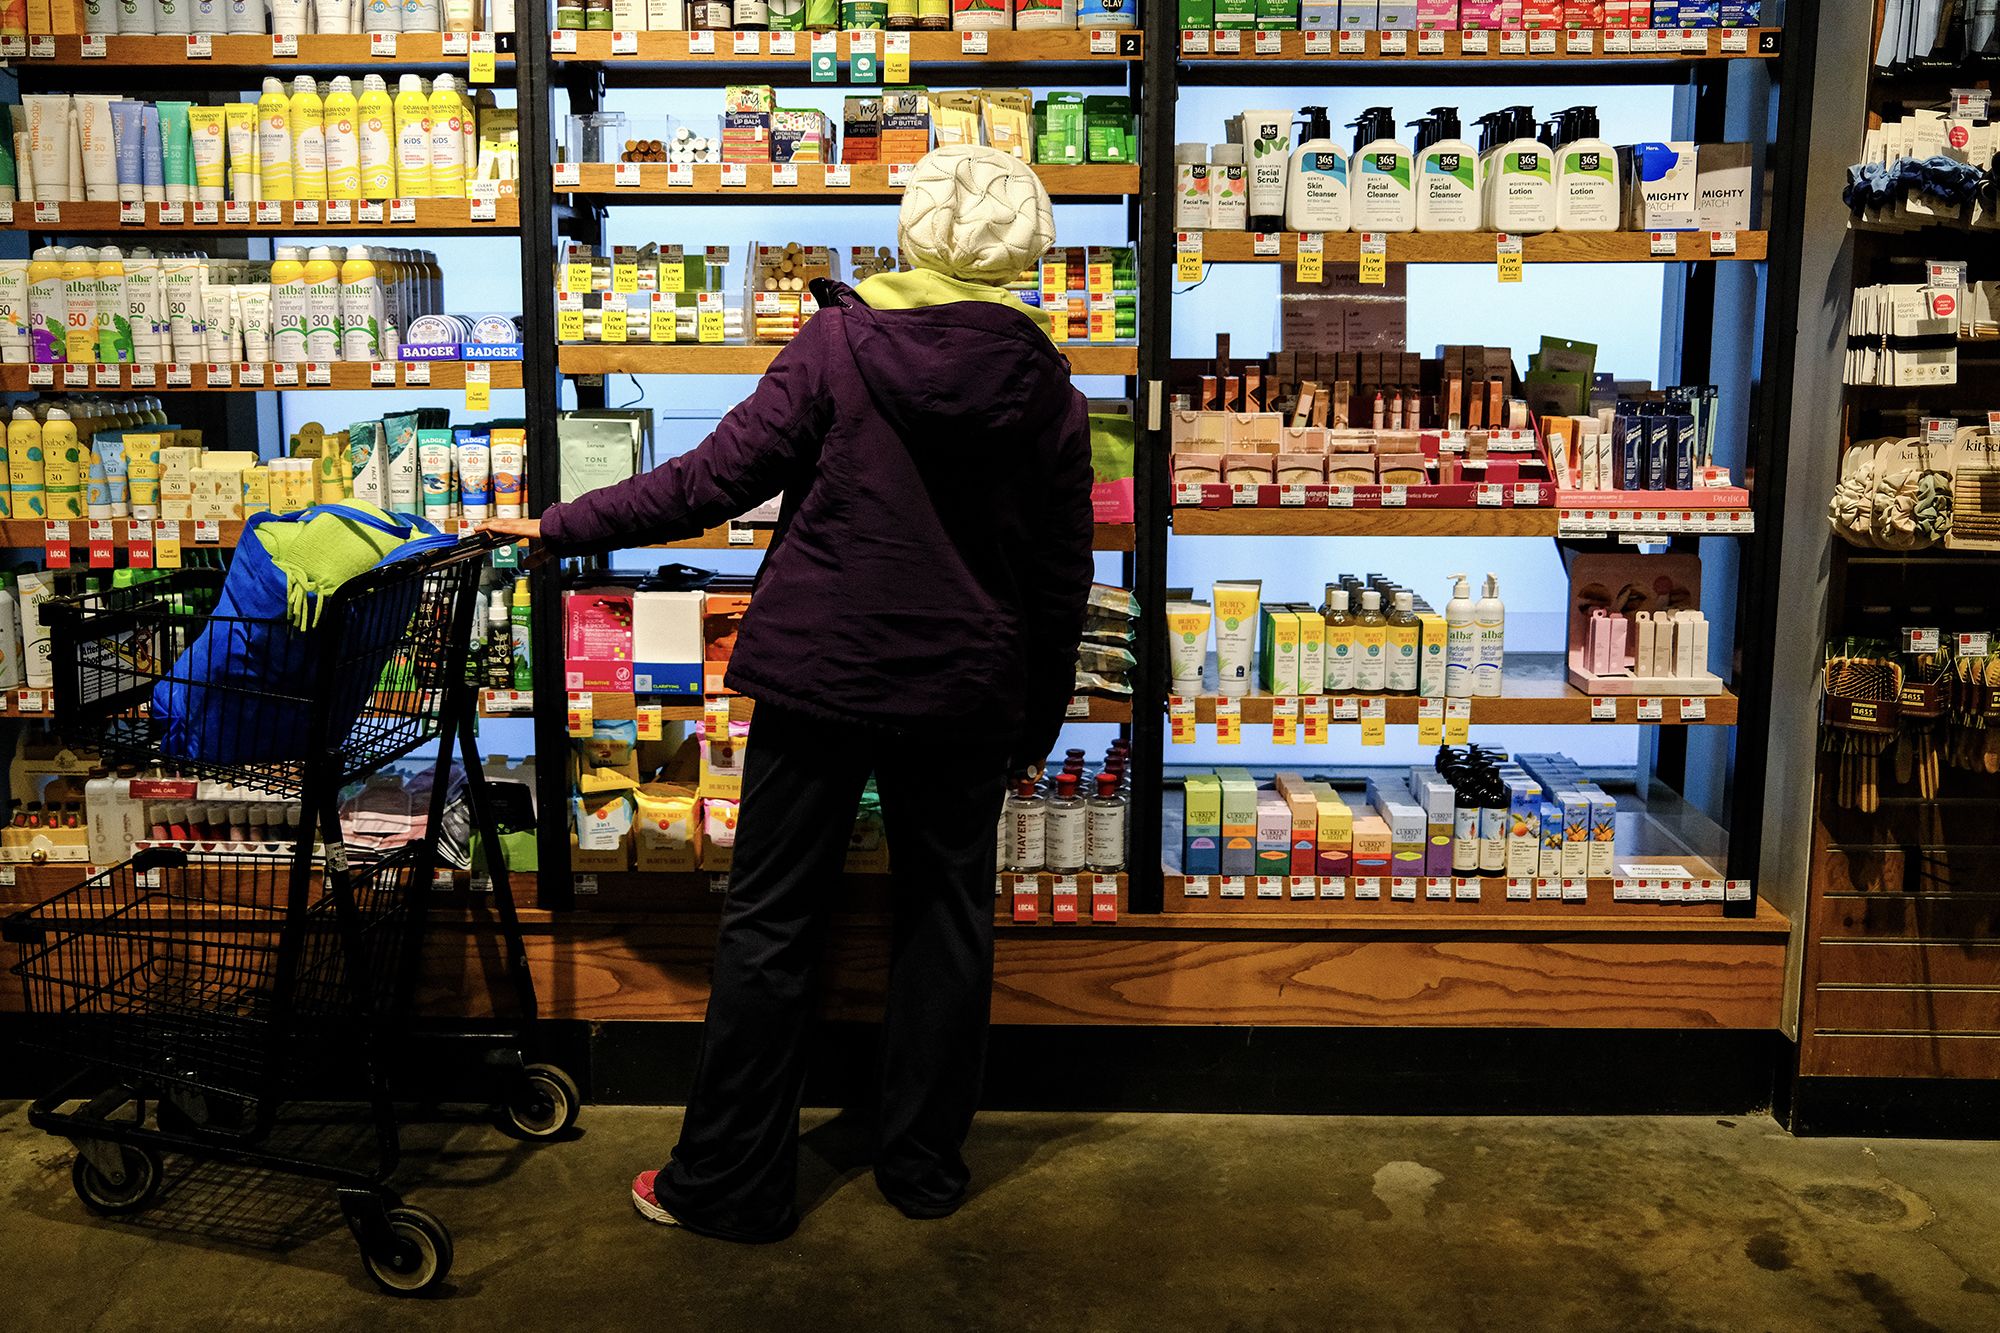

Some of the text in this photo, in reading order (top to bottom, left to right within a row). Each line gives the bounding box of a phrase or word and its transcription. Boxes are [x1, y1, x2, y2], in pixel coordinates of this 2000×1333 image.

[1102, 0, 1122, 8] CLAY
[501, 36, 507, 48] 1
[1126, 40, 1134, 51] 2
[1050, 103, 1078, 111] WELEDA
[271, 118, 284, 127] 40
[368, 121, 381, 129] 50
[448, 119, 460, 129] 50
[338, 123, 351, 132] 60
[1261, 126, 1276, 136] 365
[1316, 154, 1333, 165] 365
[1377, 155, 1394, 166] 365
[1440, 156, 1458, 165] 365
[1519, 155, 1536, 165] 365
[1580, 155, 1598, 165] 365
[1193, 167, 1205, 175] 365
[1228, 167, 1241, 176] 365
[1256, 168, 1279, 176] Facial
[1256, 176, 1279, 184] Scrub
[499, 185, 512, 194] 20
[1306, 182, 1323, 190] Skin
[1367, 182, 1389, 190] Facial
[1306, 190, 1337, 198] Cleanser
[1429, 191, 1461, 199] Cleanser
[1570, 187, 1594, 195] Lotion
[1701, 189, 1744, 198] MIGHTY
[1646, 192, 1690, 201] MIGHTY
[1701, 199, 1729, 208] PATCH
[618, 267, 633, 275] Low
[665, 266, 679, 274] Low
[1179, 264, 1200, 273] Price
[1299, 264, 1320, 273] Price
[1362, 265, 1383, 273] Price
[127, 274, 150, 283] alba
[167, 274, 190, 283] alba
[569, 275, 589, 283] Price
[616, 275, 635, 283] Price
[662, 274, 682, 282] Price
[65, 281, 94, 293] alba
[278, 284, 304, 295] alba
[310, 284, 335, 295] alba
[345, 284, 370, 295] alba
[130, 302, 146, 314] 50
[170, 302, 185, 313] 30
[68, 312, 86, 326] 50
[280, 314, 298, 326] 50
[312, 314, 330, 326] 30
[346, 314, 363, 326] 30
[564, 314, 578, 322] Low
[607, 315, 622, 323] Low
[656, 315, 670, 323] Low
[703, 315, 718, 323] Low
[562, 322, 581, 331] Price
[604, 323, 624, 331] Price
[653, 323, 673, 331] Price
[701, 323, 721, 331] Price
[402, 346, 454, 357] BADGER
[466, 347, 518, 357] BADGER
[421, 437, 447, 445] BADGER
[427, 456, 439, 465] 40
[466, 456, 479, 465] 40
[500, 456, 512, 464] 40
[401, 465, 413, 474] 30
[366, 482, 377, 491] 30
[285, 498, 297, 507] 30
[1712, 494, 1745, 503] PACIFICA
[50, 549, 67, 558] LOCAL
[93, 549, 110, 558] LOCAL
[132, 549, 150, 558] LOCAL
[1219, 600, 1246, 608] BURT'S
[1449, 629, 1472, 640] alba
[1480, 629, 1503, 640] alba
[1901, 692, 1922, 701] BASS
[1853, 707, 1874, 716] BASS
[1226, 811, 1253, 819] CURRENT
[1016, 812, 1027, 861] THAYERS
[1017, 903, 1035, 913] LOCAL
[1056, 903, 1074, 913] LOCAL
[1096, 903, 1114, 913] LOCAL
